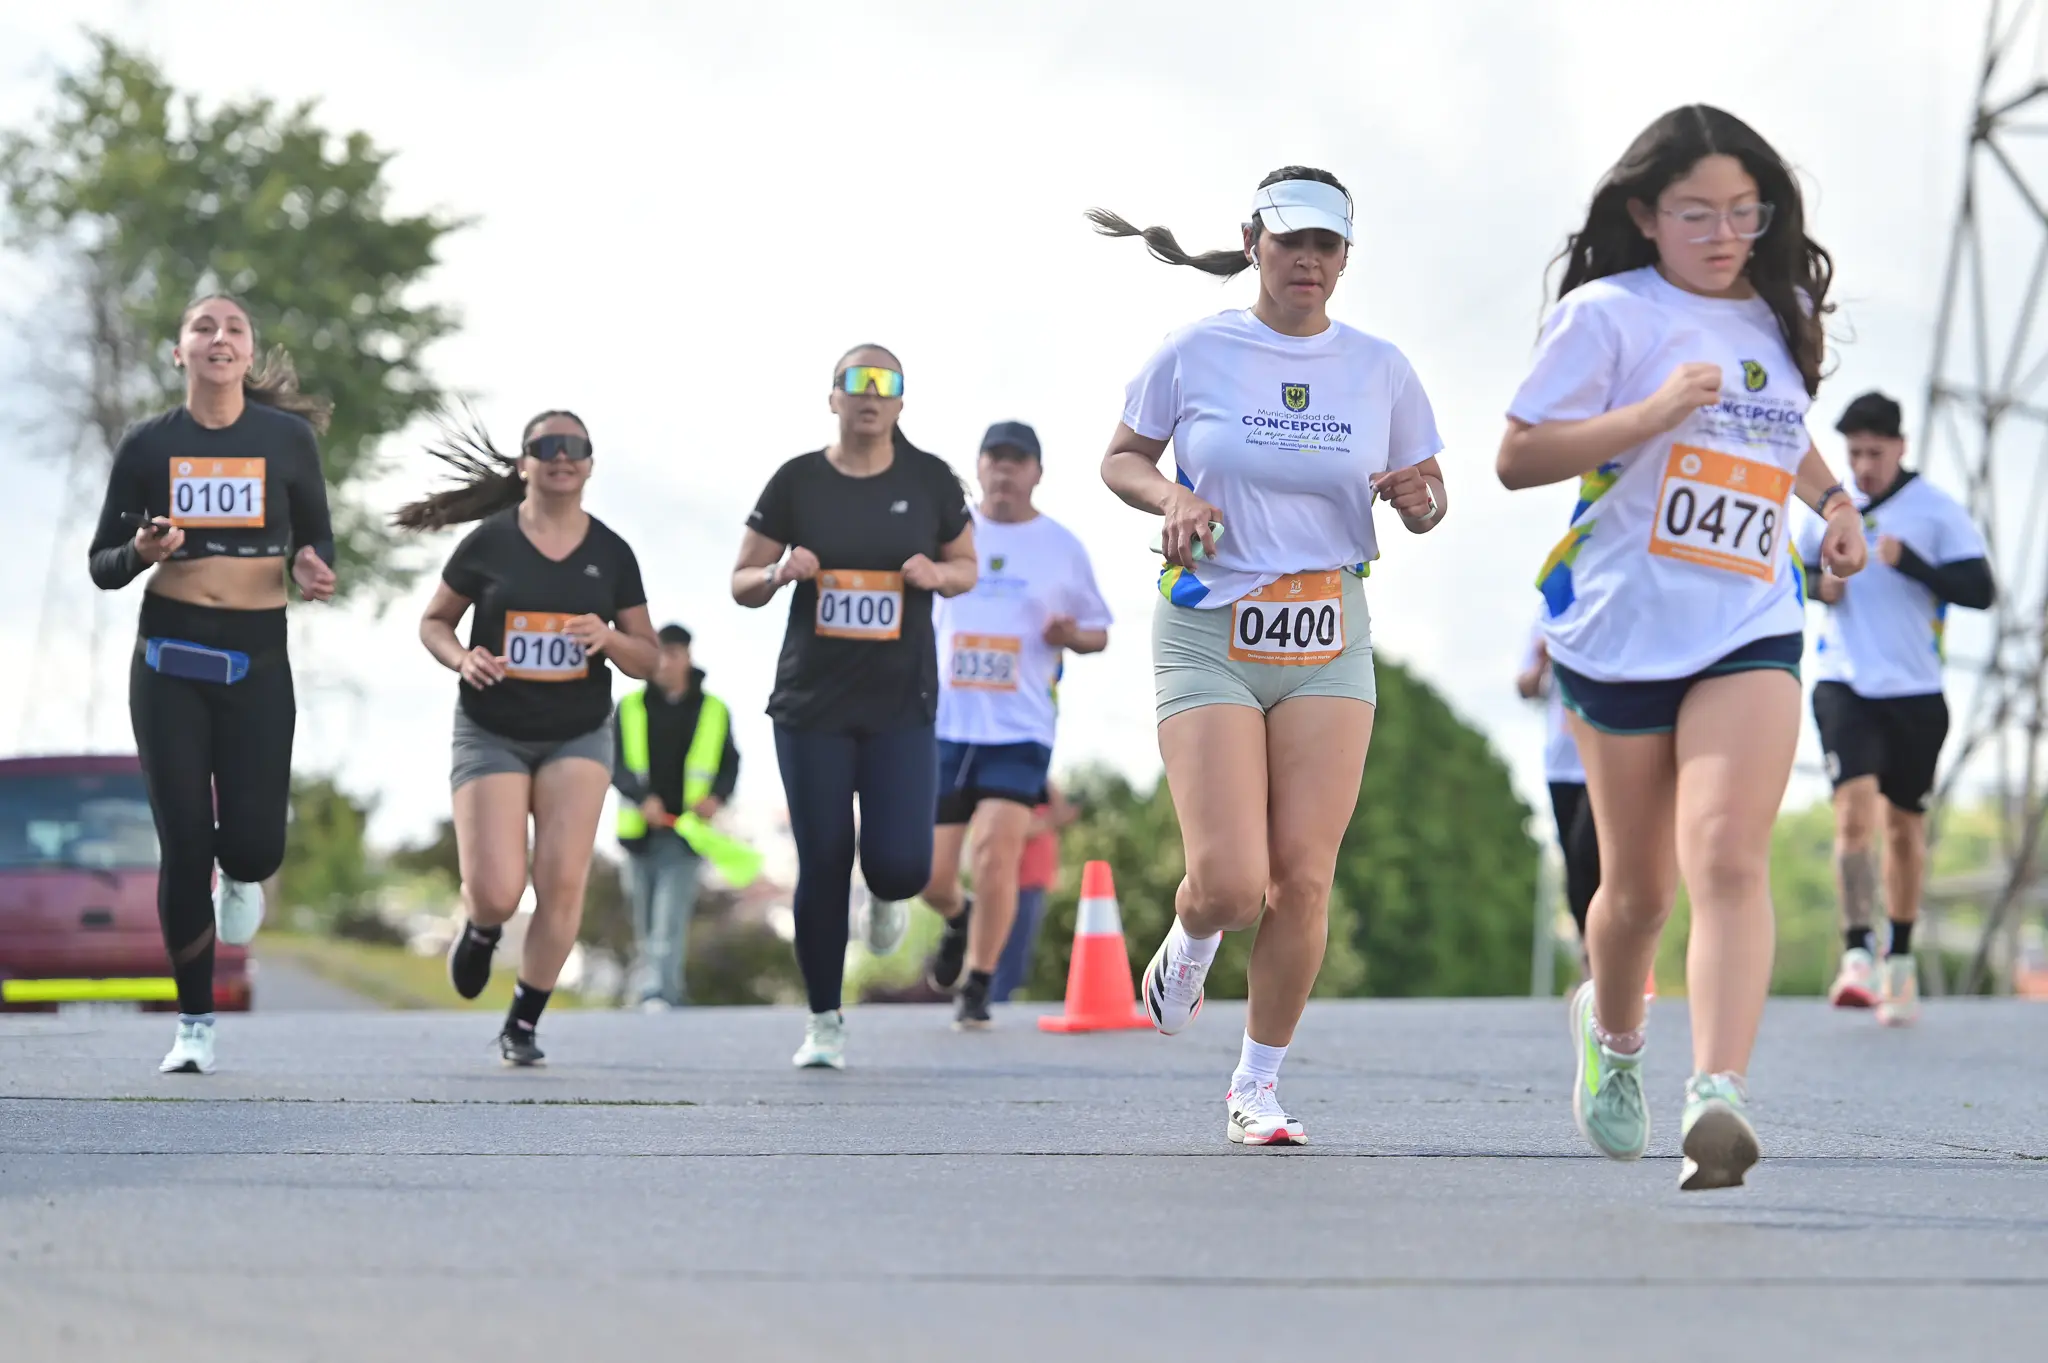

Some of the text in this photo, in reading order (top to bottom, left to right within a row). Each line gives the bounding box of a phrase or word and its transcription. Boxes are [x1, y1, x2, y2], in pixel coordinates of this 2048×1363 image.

[1241, 415, 1352, 435] CONCEPCIÓN
[1257, 409, 1336, 421] Municipalidad de
[1264, 431, 1285, 440] mejor
[1323, 433, 1348, 443] Chile!
[1279, 441, 1309, 449] Municipal
[177, 483, 252, 513] 0101
[1666, 486, 1775, 557] 0478
[822, 593, 895, 626] 0100
[1239, 604, 1336, 649] 0400
[511, 636, 582, 667] 0103
